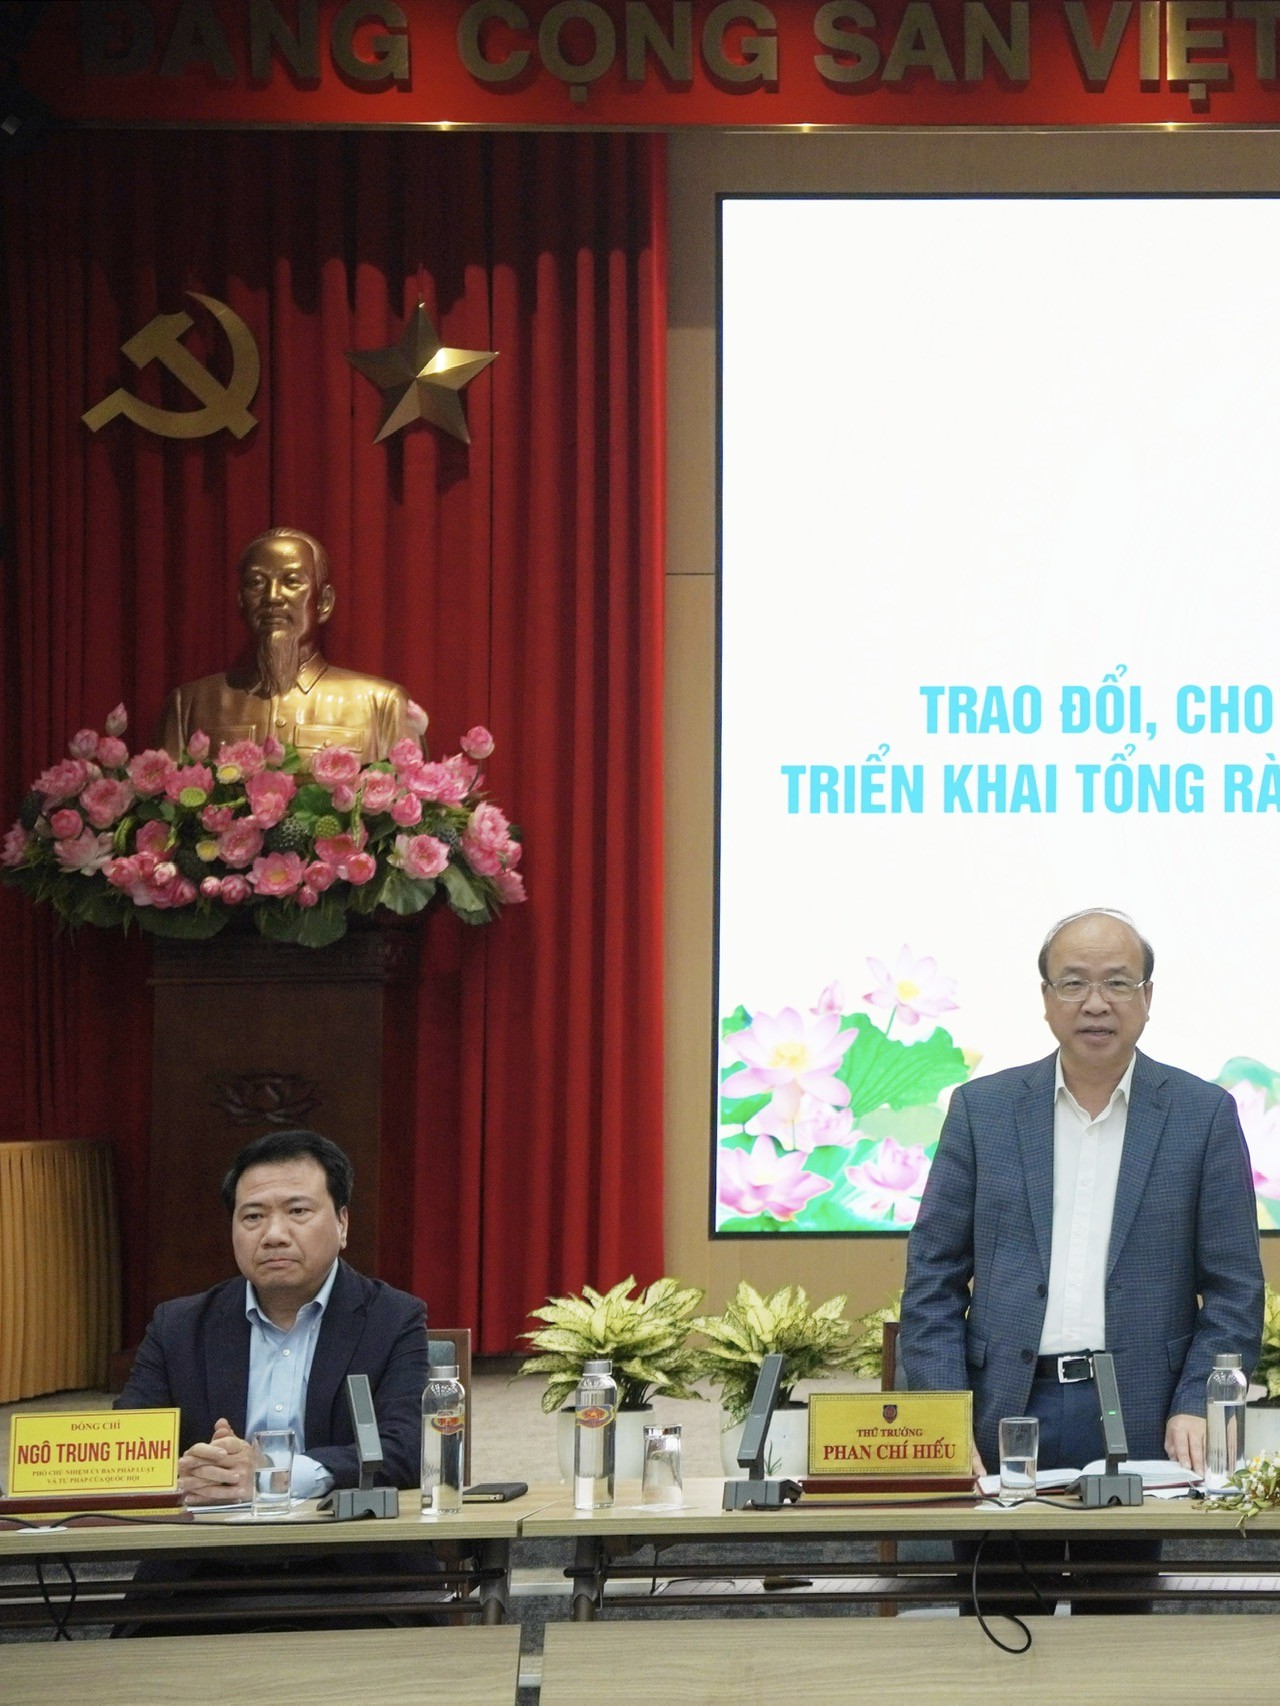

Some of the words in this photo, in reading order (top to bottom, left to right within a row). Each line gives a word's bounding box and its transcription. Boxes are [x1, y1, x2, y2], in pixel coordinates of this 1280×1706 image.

[920, 685, 1042, 734] TRAO
[1060, 664, 1157, 741] ĐỔI,
[1177, 685, 1274, 734] CHO
[781, 743, 924, 814] TRIỂN
[944, 763, 1057, 814] KHAI
[1075, 743, 1205, 813] TỔNG
[880, 1426, 923, 1437] TRƯỞNG
[17, 1440, 50, 1464] NGÔ
[56, 1442, 110, 1463] TRUNG
[115, 1436, 171, 1461] THÀNH
[823, 1444, 872, 1460] PHAN
[876, 1440, 908, 1460] CHÍ
[912, 1437, 956, 1459] HIẾU
